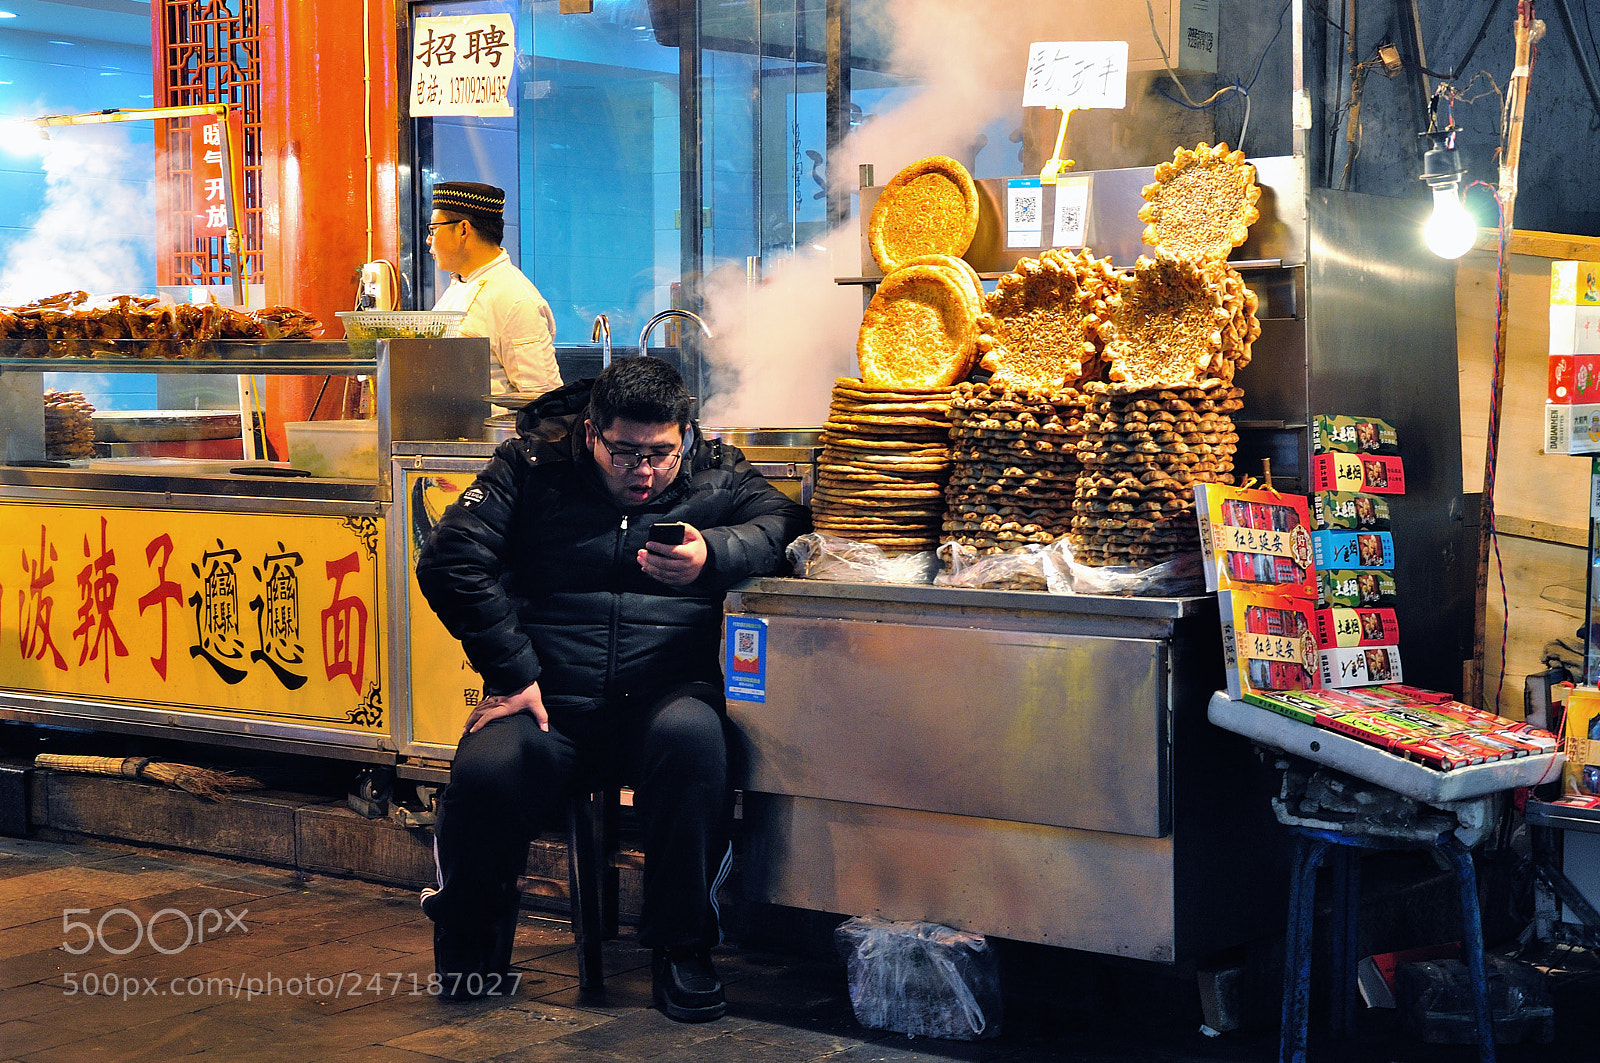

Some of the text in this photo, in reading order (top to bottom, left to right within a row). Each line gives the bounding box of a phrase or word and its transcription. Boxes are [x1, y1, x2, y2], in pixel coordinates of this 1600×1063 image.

[416, 24, 509, 68] 招聘
[1234, 529, 1284, 553] 红色延安
[1254, 636, 1295, 660] 红色延安
[464, 688, 480, 706] 留
